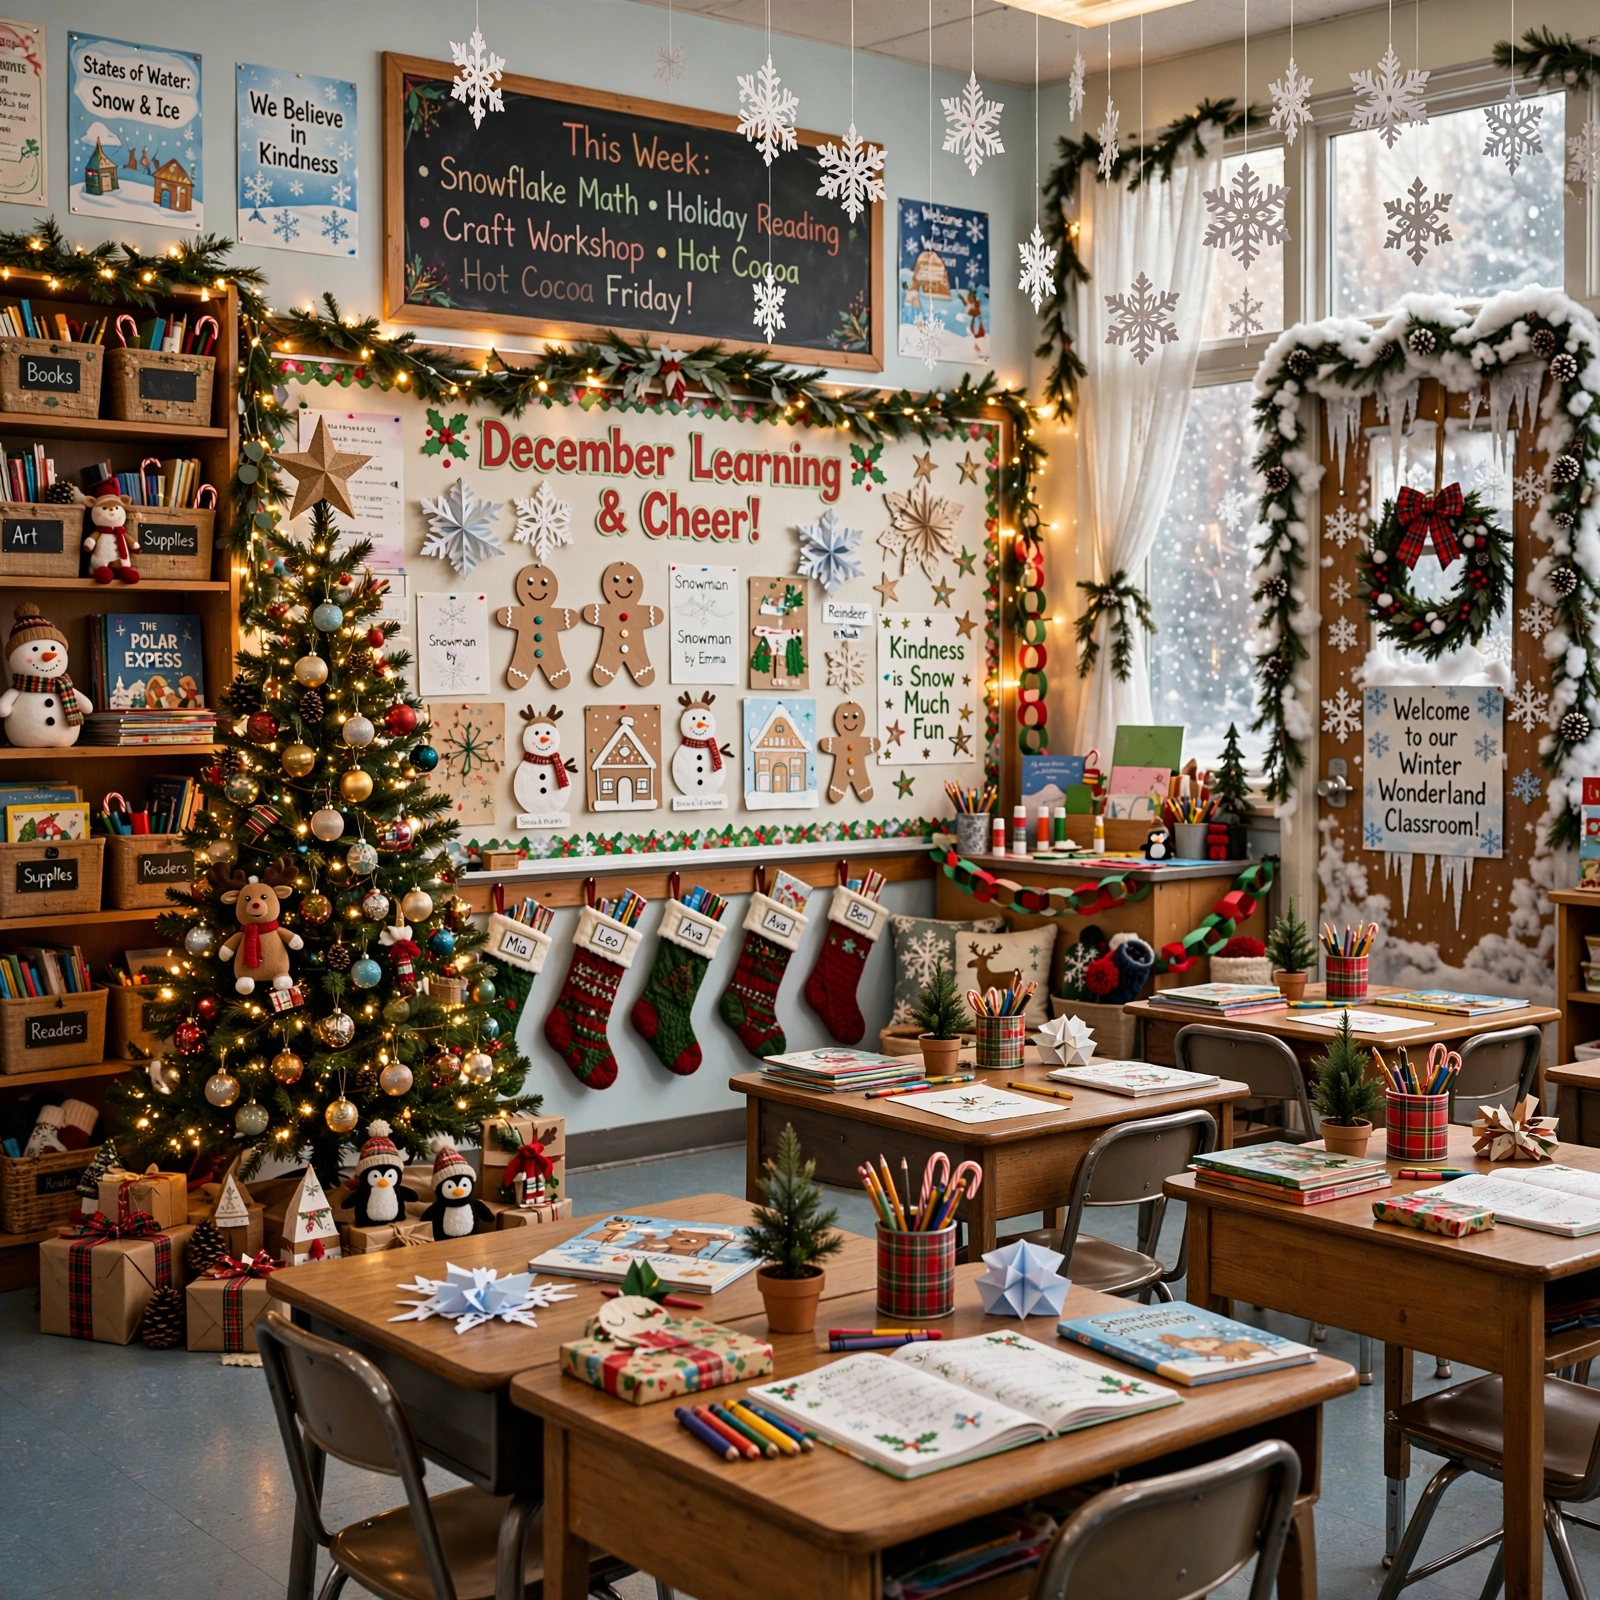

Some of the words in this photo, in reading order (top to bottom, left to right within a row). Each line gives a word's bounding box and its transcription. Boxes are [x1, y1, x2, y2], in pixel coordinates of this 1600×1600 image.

[84, 55, 125, 80] States
[130, 64, 144, 81] of
[146, 66, 191, 90] Water:
[92, 86, 134, 113] Snow
[140, 99, 152, 115] &
[156, 97, 181, 120] Ice
[250, 91, 278, 117] We
[283, 97, 344, 129] Believe
[290, 124, 307, 145] in
[259, 142, 339, 175] Kindness
[562, 122, 622, 164] This
[632, 132, 710, 176] Week:
[440, 156, 567, 205] Snowflake
[579, 176, 639, 216] Math
[667, 190, 749, 242] Holiday
[757, 203, 840, 258] Reading
[442, 208, 515, 248] Craft
[527, 217, 645, 274] Workshop
[677, 238, 721, 275] Hot
[732, 247, 800, 285] Cocoa
[463, 258, 509, 295] Hot
[521, 266, 594, 302] Cocoa
[606, 274, 694, 326] Friday!
[27, 361, 74, 386] Books
[480, 416, 676, 479] December
[690, 431, 843, 503] Learning
[596, 486, 628, 537] &
[640, 490, 761, 543] Cheer!
[12, 525, 39, 545] Art
[675, 574, 729, 591] Snowman
[828, 604, 868, 620] Reindeer
[139, 621, 158, 631] THE
[677, 629, 732, 645] Snowman
[130, 633, 178, 650] POLAR
[889, 636, 965, 661] Kindness
[124, 651, 183, 669] EXPESS
[446, 651, 457, 666] by
[684, 651, 695, 668] by
[893, 670, 903, 687] is
[910, 666, 955, 688] Snow
[904, 690, 950, 715] Much
[1393, 697, 1470, 721] Welcome
[914, 718, 945, 740] Fun
[1405, 726, 1422, 747] to
[1429, 731, 1458, 747] our
[1399, 752, 1462, 776] Winter
[1378, 778, 1487, 806] Wonderland
[1385, 808, 1480, 837] Classroom!
[143, 860, 187, 876] Readers
[766, 914, 787, 932] Ava
[850, 905, 869, 923] Ben
[598, 929, 619, 948] Leo
[682, 923, 703, 941] Ava
[505, 935, 527, 955] Mia
[31, 1018, 83, 1040] Readers
